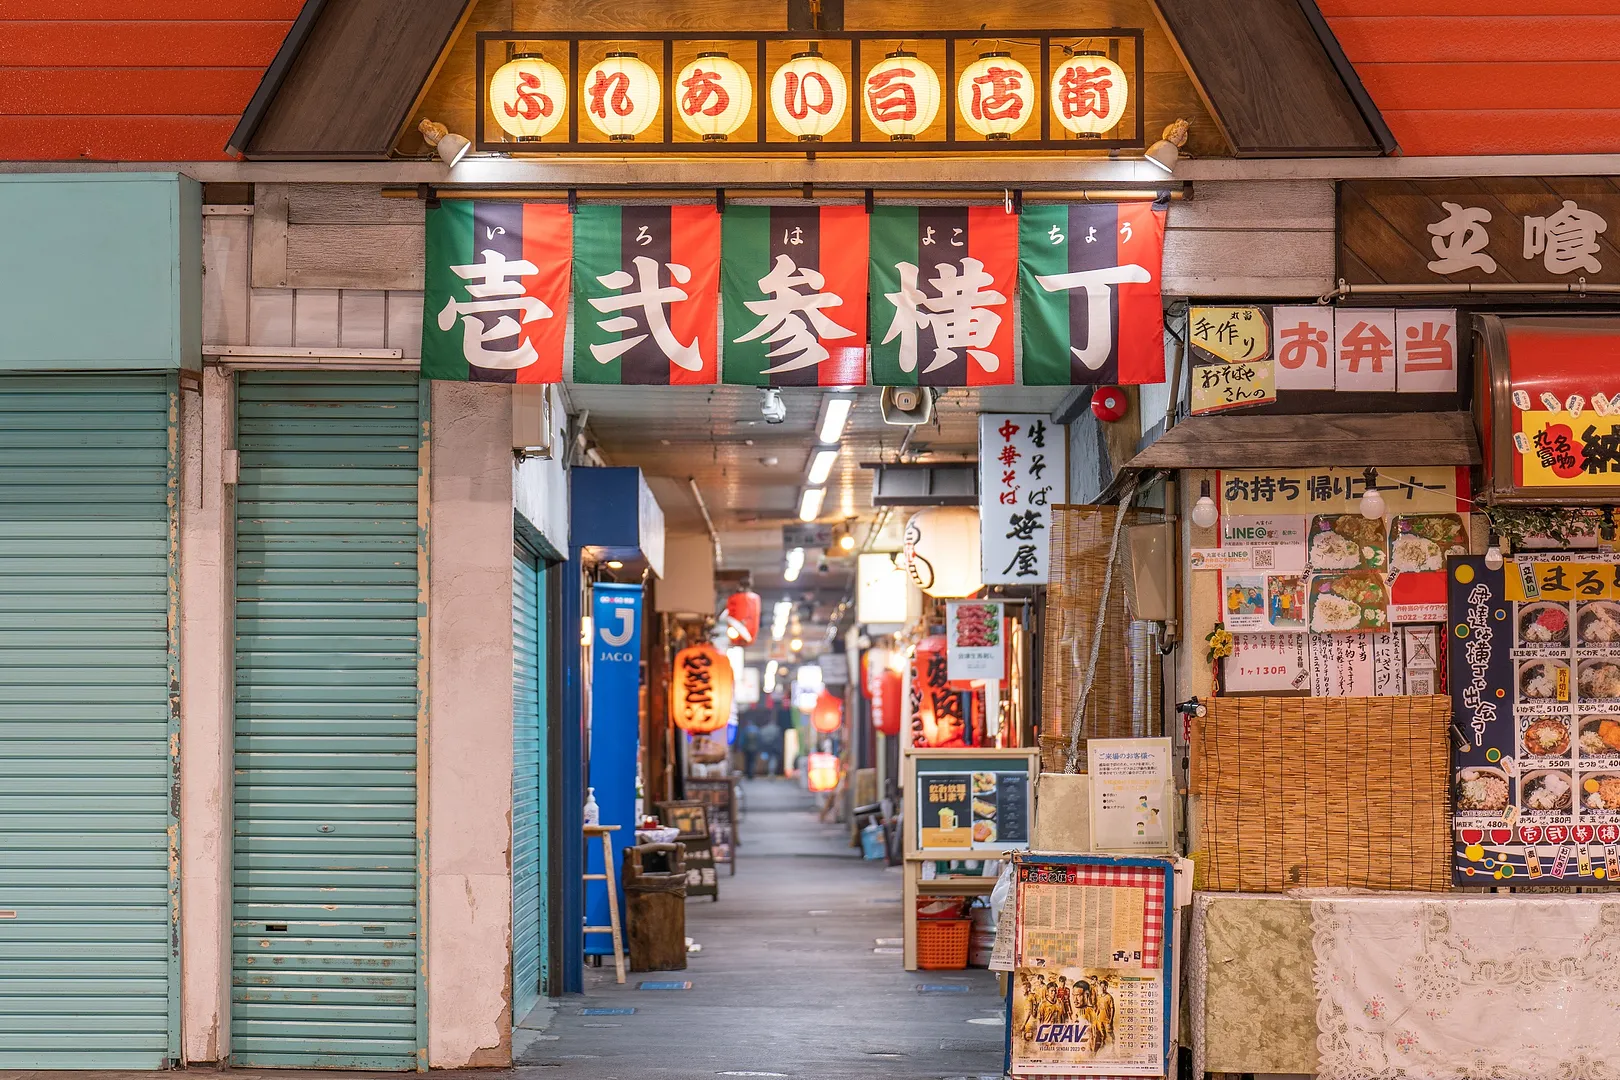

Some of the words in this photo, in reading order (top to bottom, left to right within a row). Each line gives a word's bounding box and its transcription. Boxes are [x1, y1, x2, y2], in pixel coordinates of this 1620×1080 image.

[503, 67, 1113, 121] ふれあい百店街
[1194, 317, 1255, 358] 手作り
[1279, 321, 1453, 374] お弁当
[1201, 364, 1255, 388] おそばや
[1223, 387, 1265, 402] さんの
[998, 419, 1021, 505] 中華そば
[1027, 419, 1053, 506] 生そば
[1533, 430, 1557, 469] 丸富
[1554, 435, 1576, 469] 名物
[1002, 509, 1045, 577] 笹屋
[600, 651, 634, 662] JACO
[1558, 669, 1567, 697] 売り切れ
[1579, 847, 1589, 872] そば
[1607, 848, 1618, 876] お弁当
